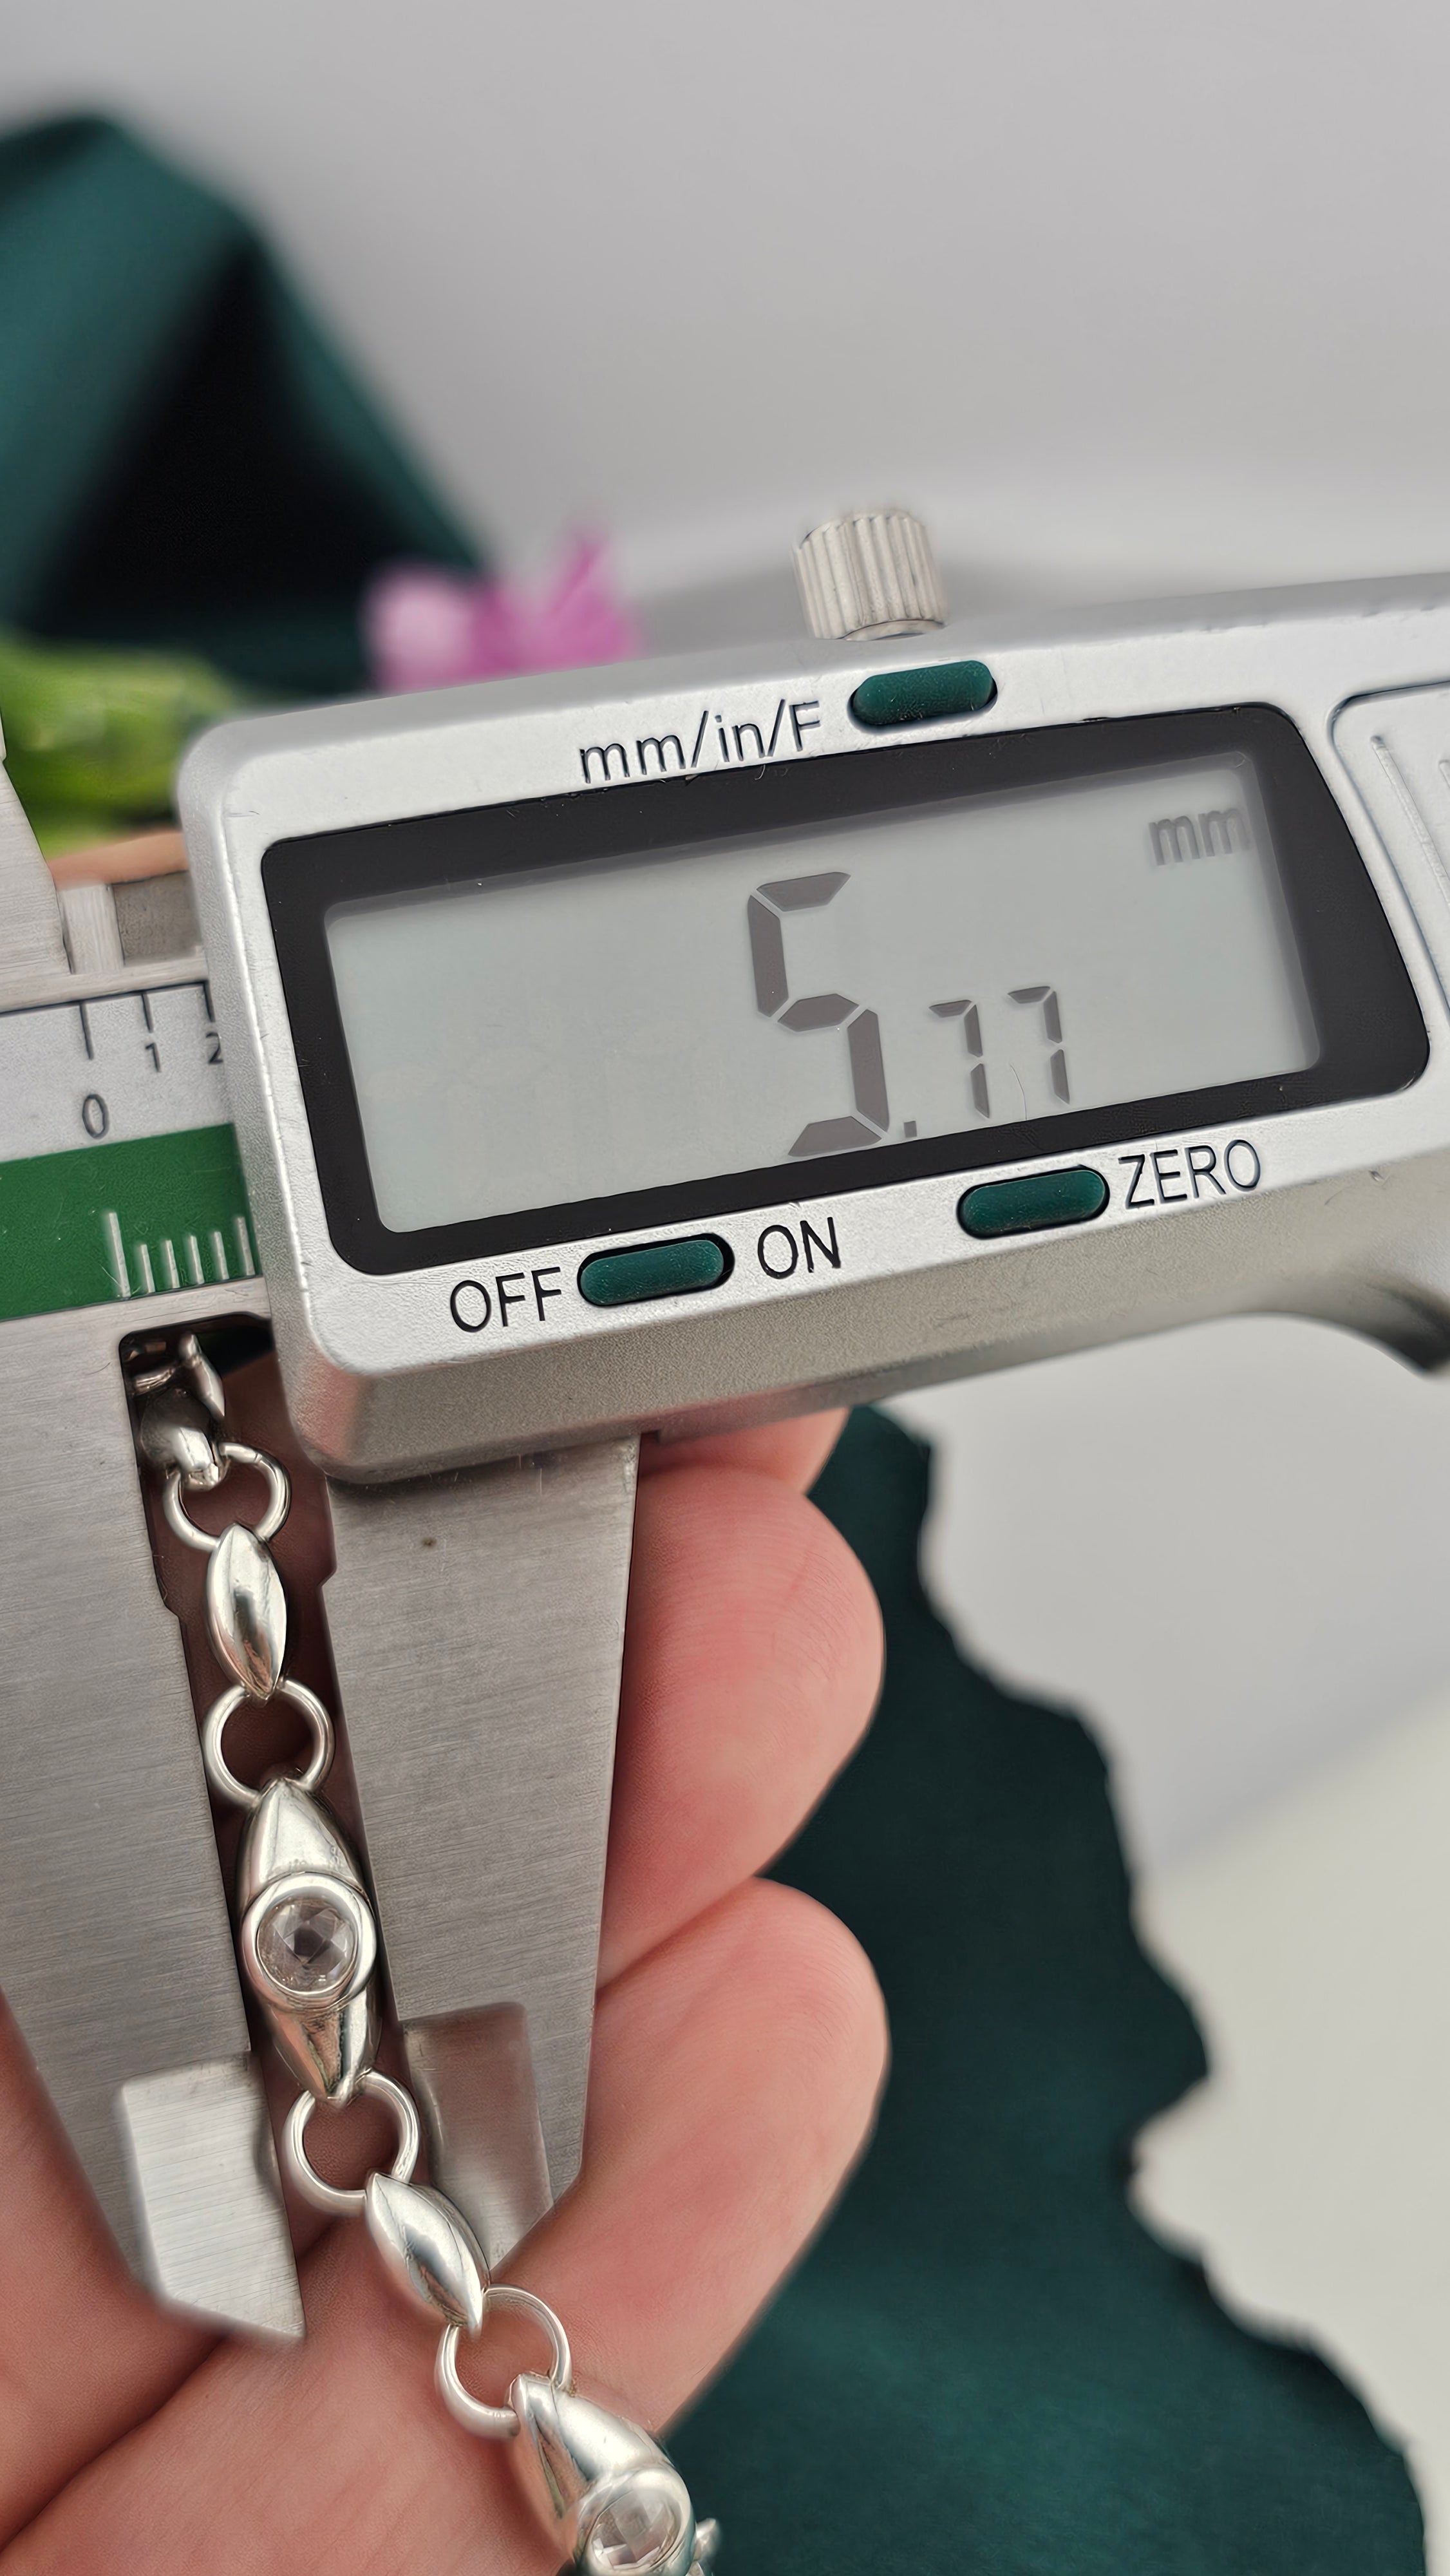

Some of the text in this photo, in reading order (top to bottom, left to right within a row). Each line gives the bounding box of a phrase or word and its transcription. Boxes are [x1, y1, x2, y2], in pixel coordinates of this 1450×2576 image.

[579, 697, 821, 784] mm/in/F
[1147, 806, 1252, 867] mm
[747, 871, 1071, 1157] 5.77
[145, 1031, 223, 1073] 1 2
[81, 1094, 109, 1138] 0
[1116, 1138, 1263, 1209] ZERO
[449, 1216, 843, 1332] OFF ON
